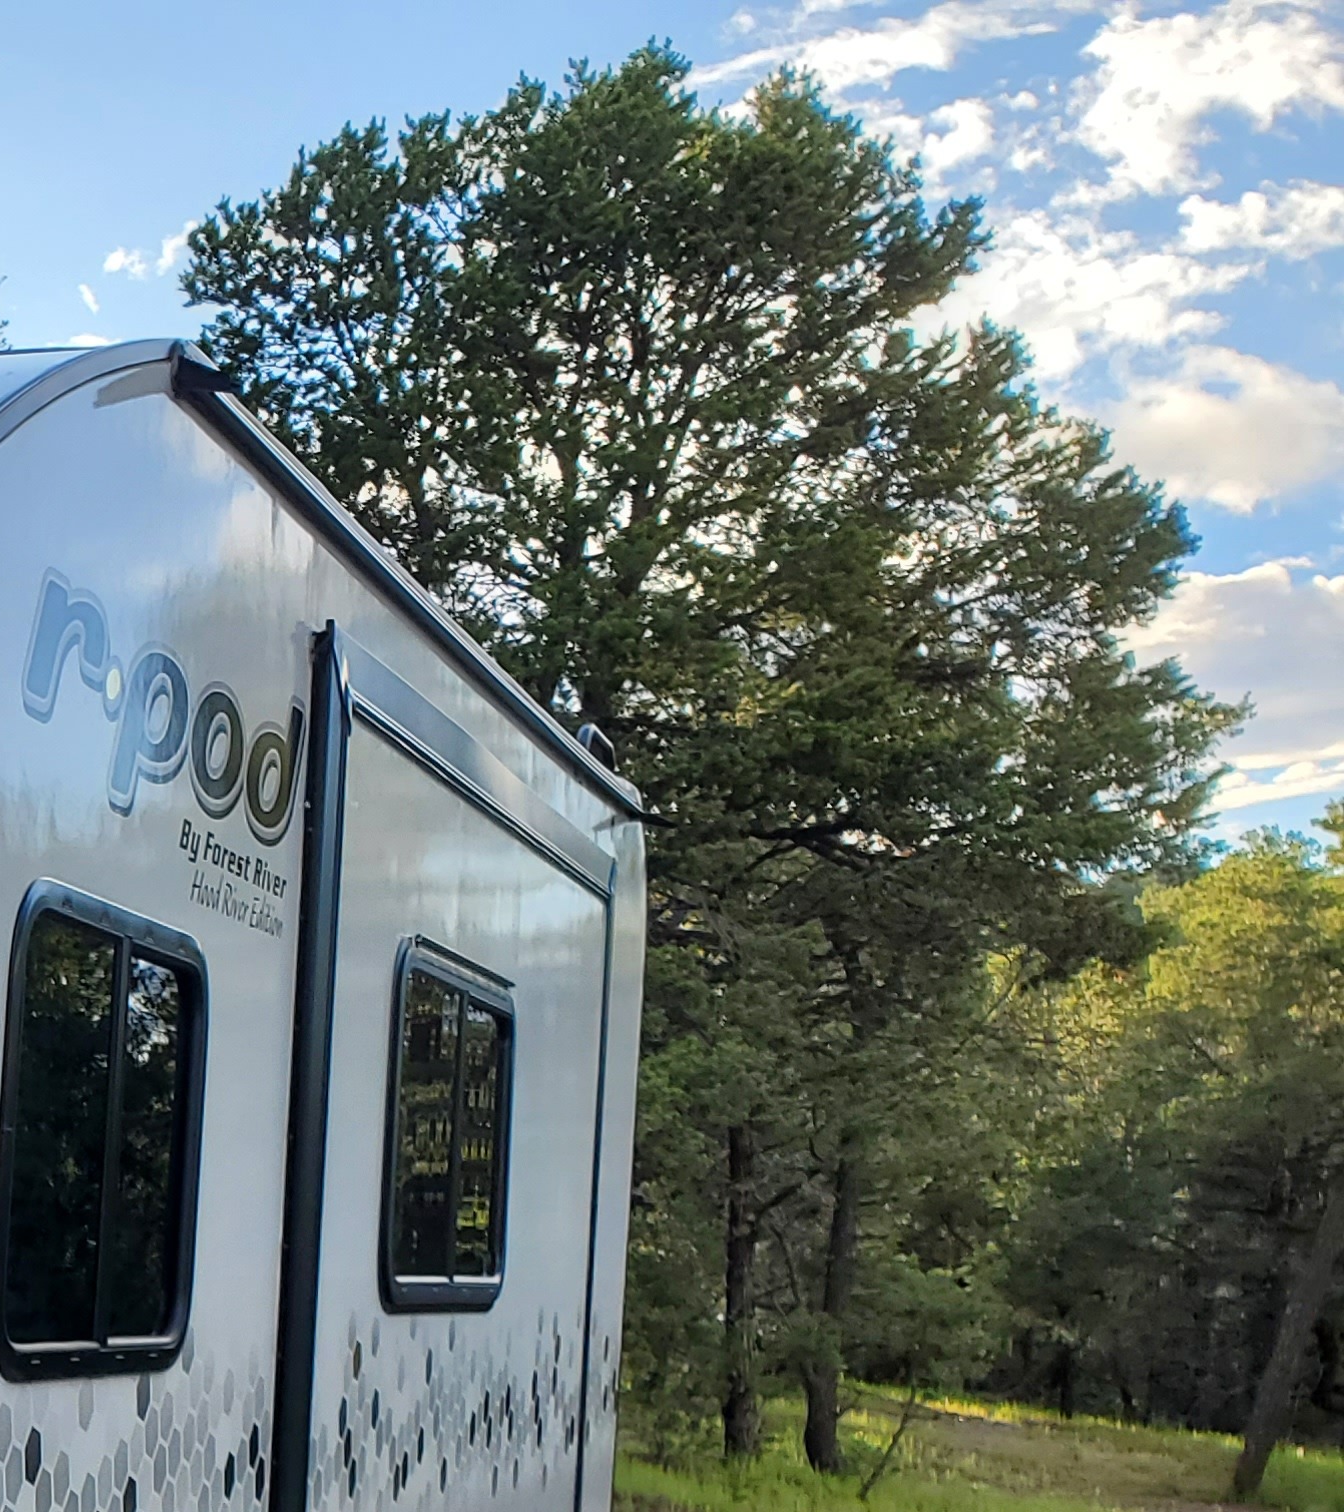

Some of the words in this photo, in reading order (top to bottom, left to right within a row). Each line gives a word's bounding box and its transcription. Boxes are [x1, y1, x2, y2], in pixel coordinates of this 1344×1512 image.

[179, 818, 201, 864] By
[203, 831, 251, 882] Forest
[252, 857, 288, 900] River
